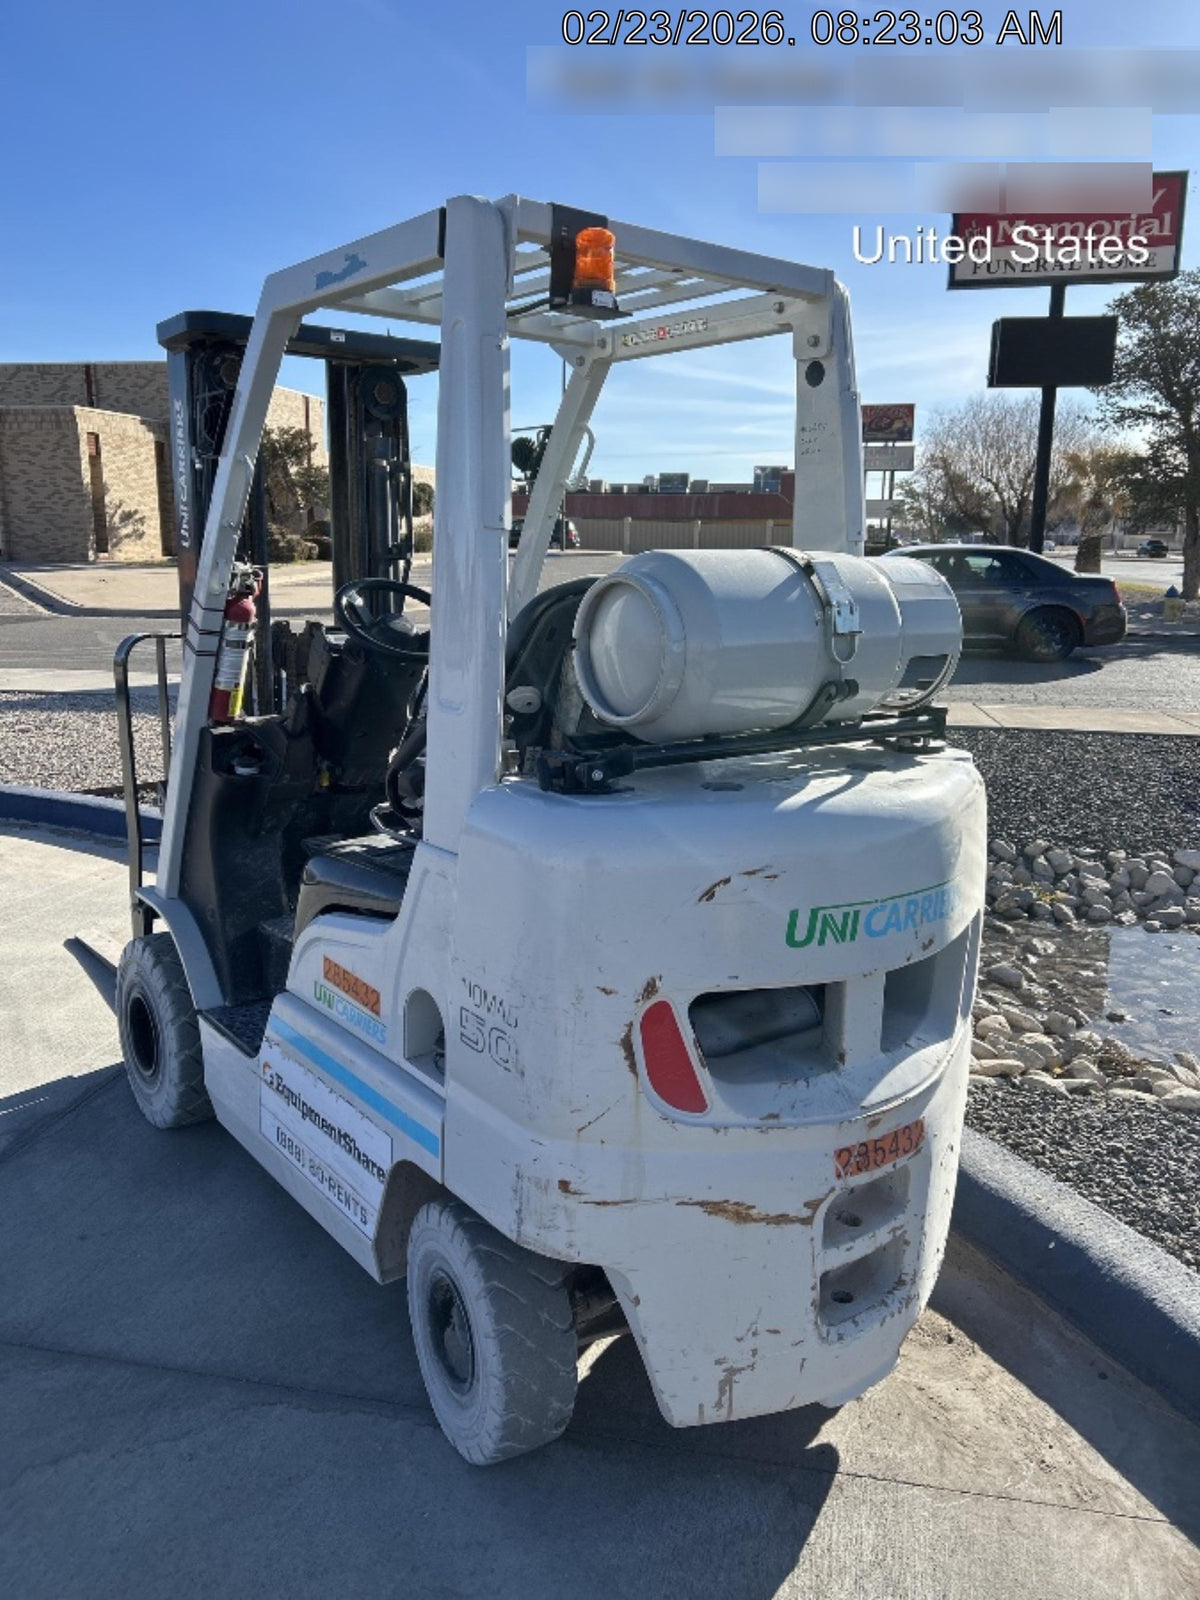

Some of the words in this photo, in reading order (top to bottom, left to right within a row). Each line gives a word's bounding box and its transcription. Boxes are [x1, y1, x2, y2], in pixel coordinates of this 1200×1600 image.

[997, 211, 1172, 243] Memorial
[972, 254, 1082, 275] FUNERAL
[313, 980, 387, 1045] UNICARRIERS
[323, 955, 381, 1018] 285432
[275, 1072, 387, 1184] EquipmentShare
